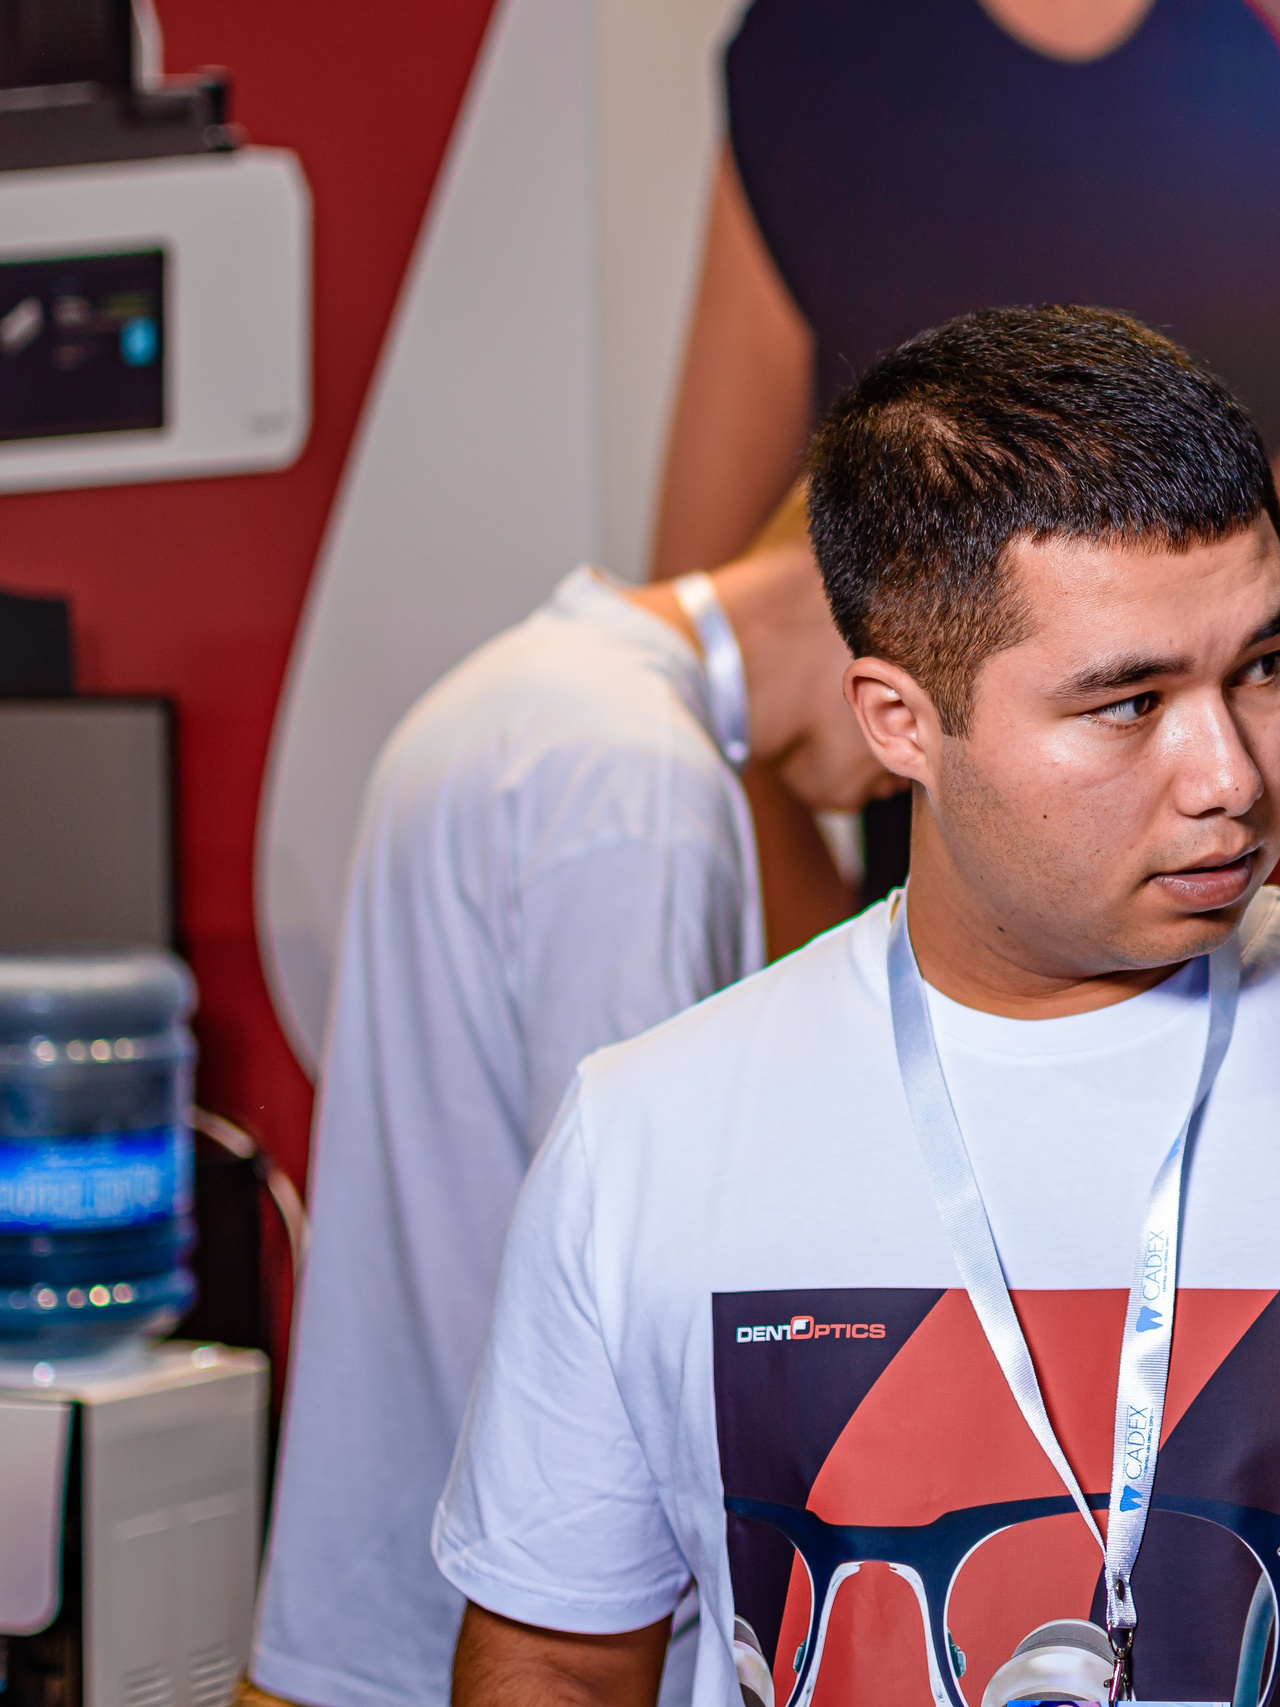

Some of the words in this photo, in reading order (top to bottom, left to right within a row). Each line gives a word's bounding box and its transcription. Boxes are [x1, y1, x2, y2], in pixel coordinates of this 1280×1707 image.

[1142, 1230, 1165, 1300] CADEX
[737, 1315, 887, 1343] DENTOPTICS
[1125, 1405, 1148, 1480] CADEX
